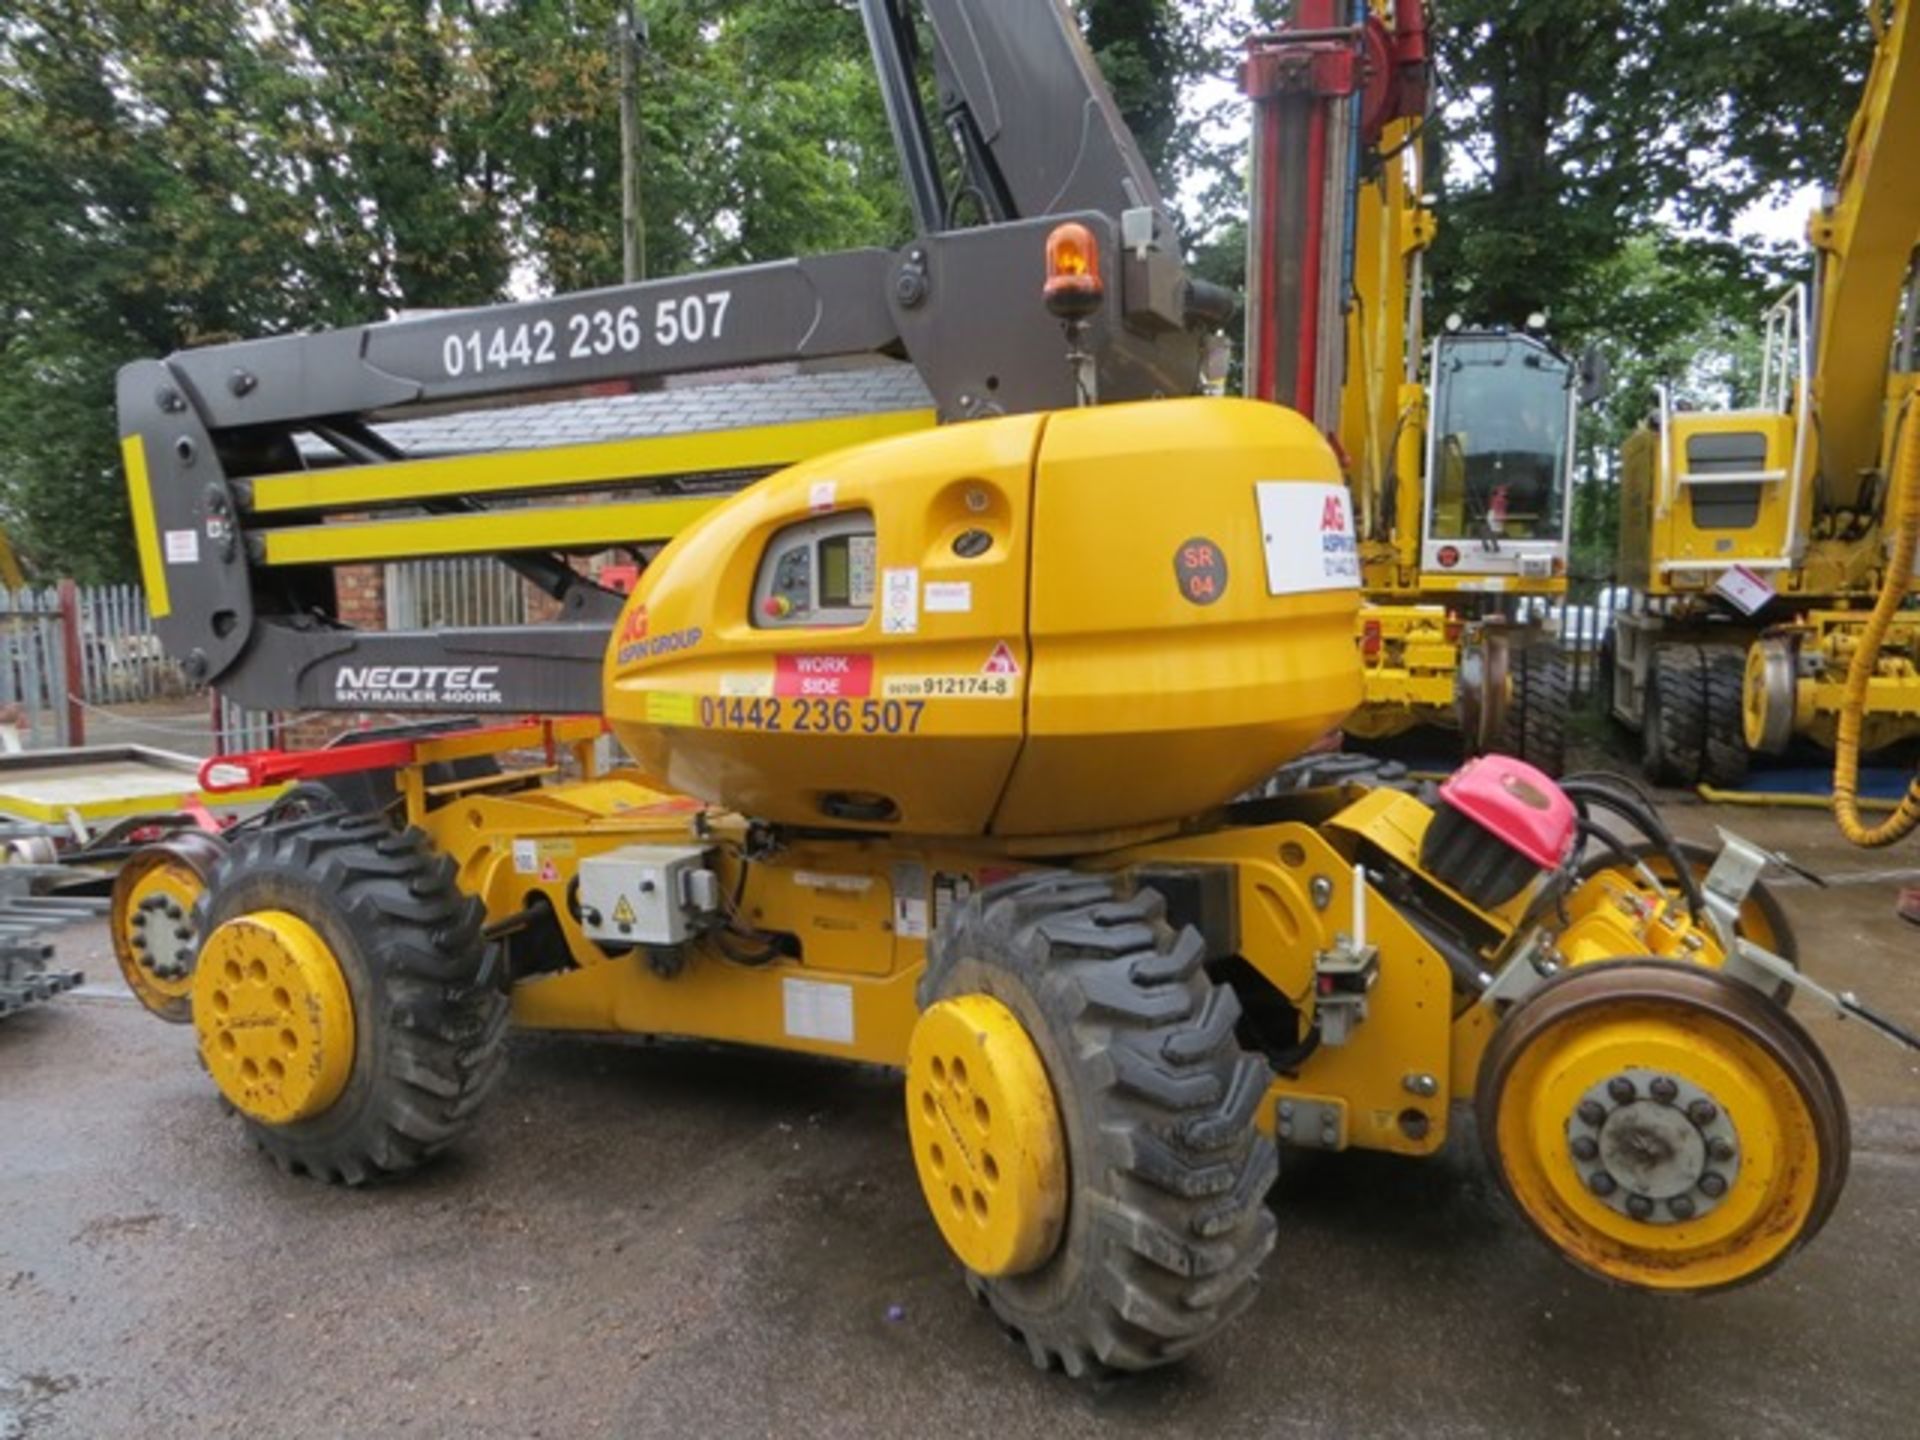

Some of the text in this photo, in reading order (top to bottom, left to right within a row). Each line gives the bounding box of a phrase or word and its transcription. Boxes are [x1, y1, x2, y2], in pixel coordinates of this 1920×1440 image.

[443, 291, 731, 376] 01442 236 507
[1320, 495, 1345, 531] AG
[1184, 547, 1214, 567] SR
[1190, 576, 1214, 596] 04
[651, 627, 702, 655] GROUP
[796, 657, 849, 673] WORK
[335, 666, 499, 689] NEOTEC
[803, 678, 841, 694] SIDE
[923, 678, 1007, 695] 912174-8
[335, 689, 501, 703] SKYRAILER 400RR
[701, 696, 781, 731] 01442
[793, 697, 852, 732] 236
[861, 700, 925, 733] 507
